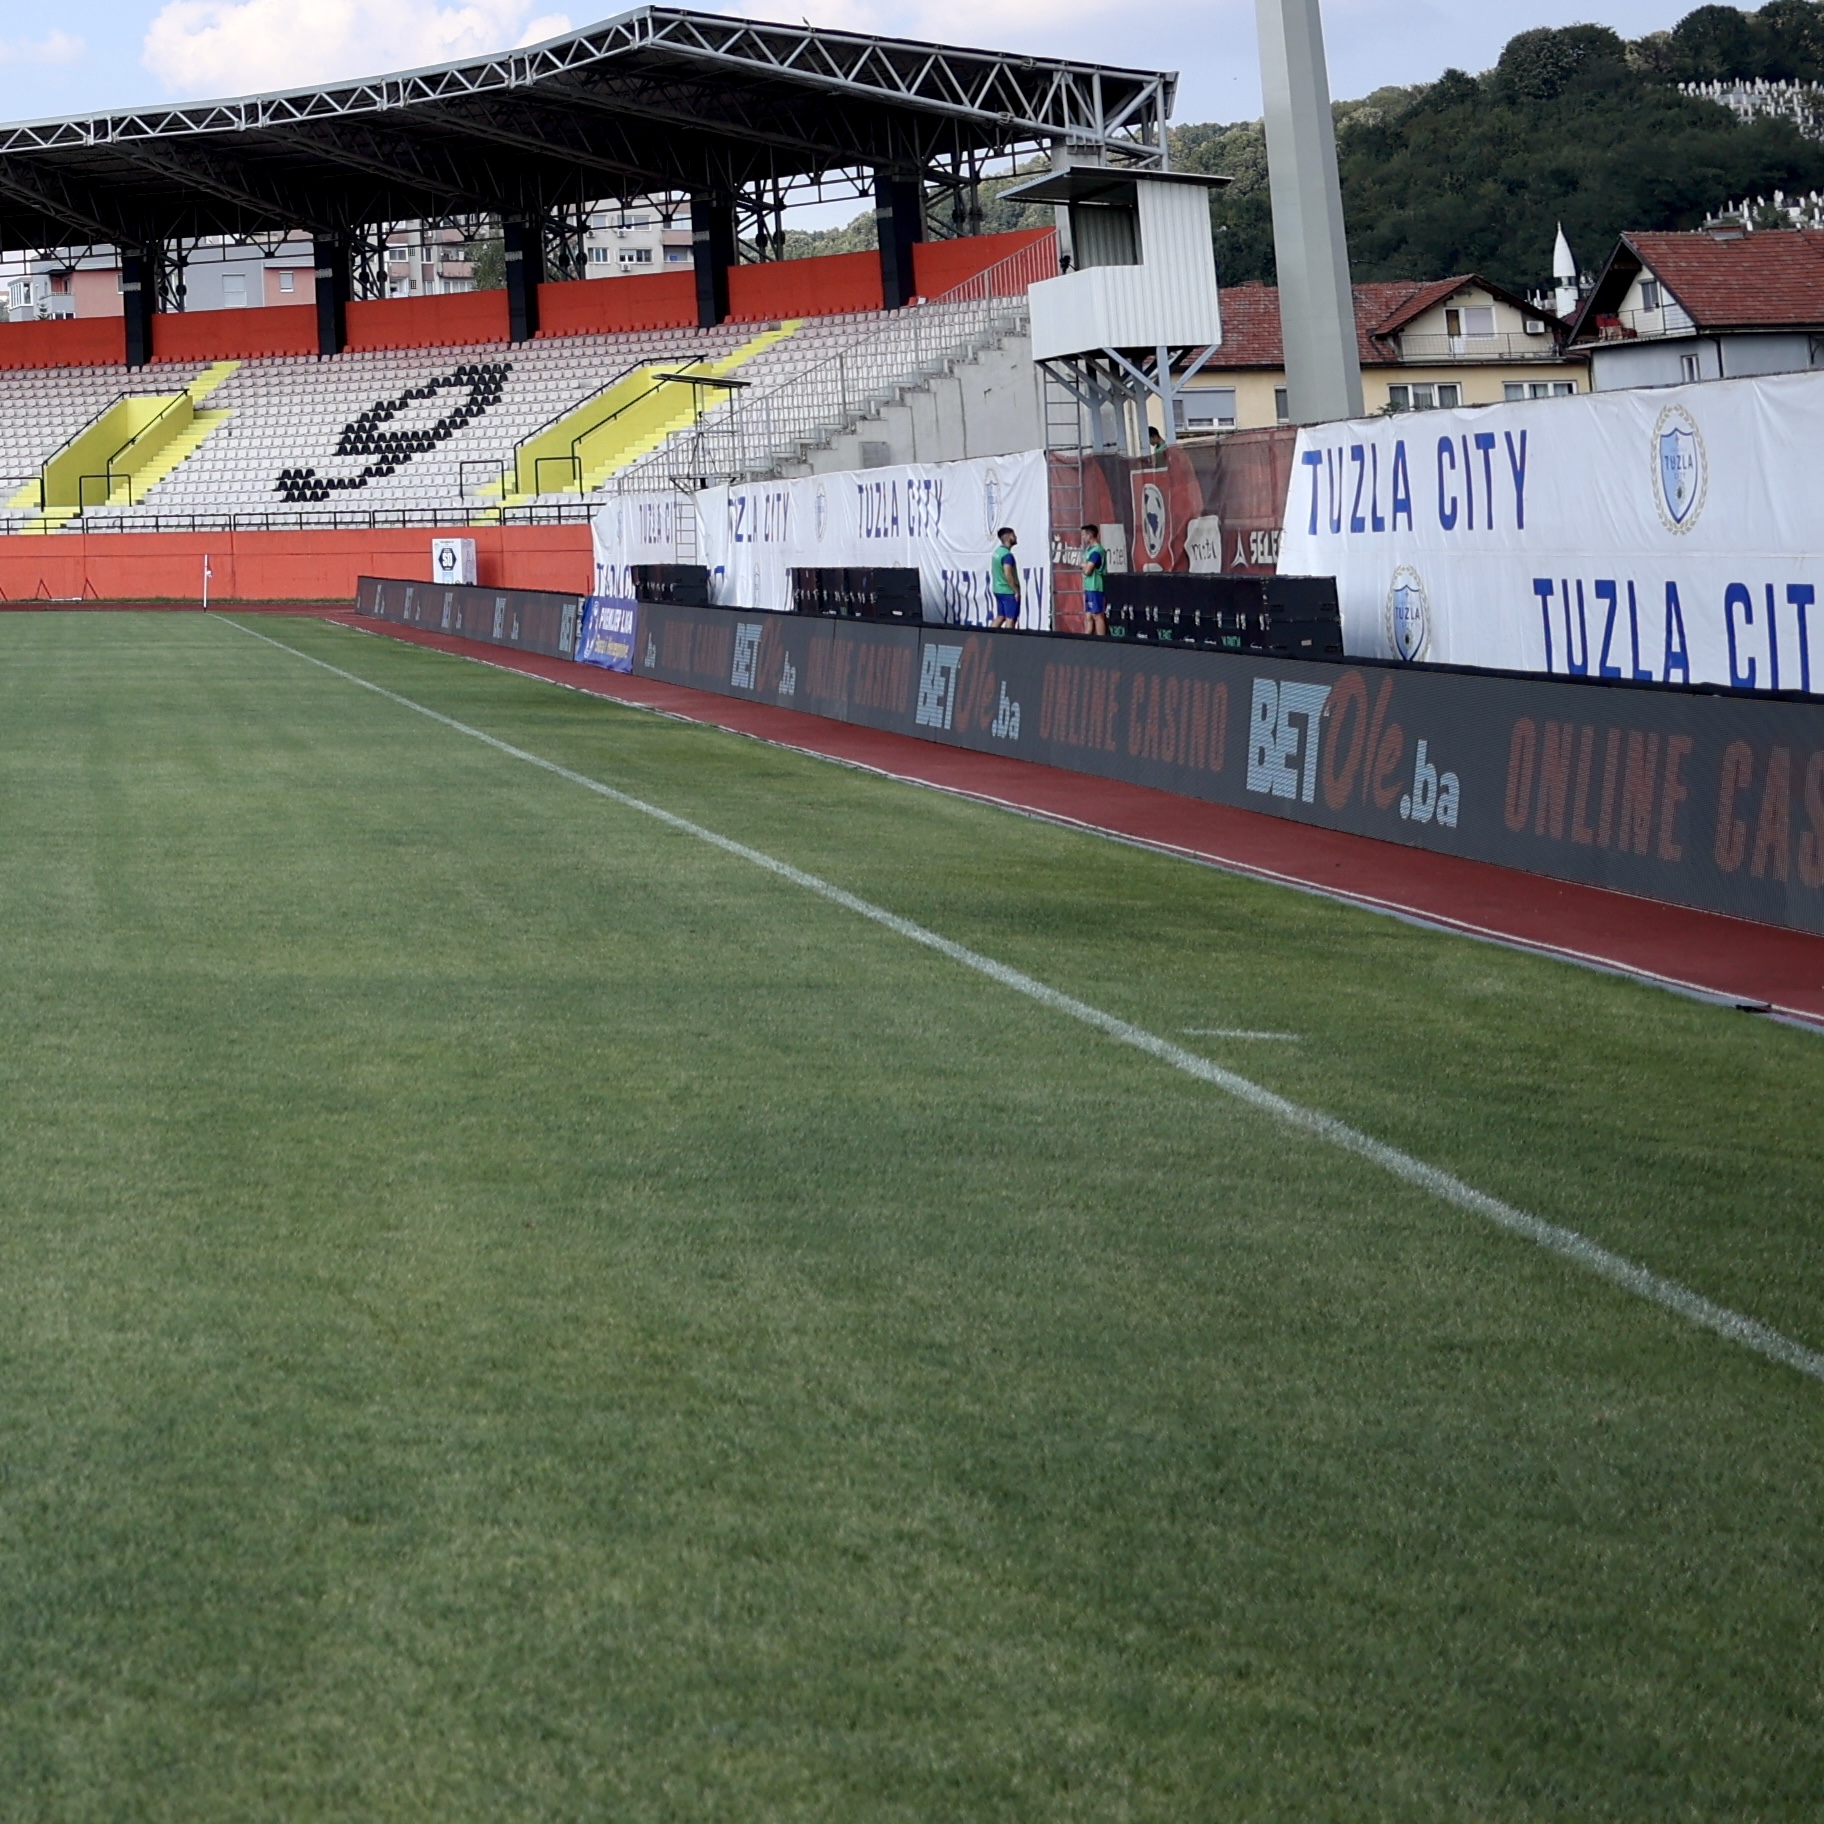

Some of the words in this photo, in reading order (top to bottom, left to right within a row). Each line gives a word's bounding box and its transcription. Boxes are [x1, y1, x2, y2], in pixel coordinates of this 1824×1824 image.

[1302, 438, 1413, 536] TUZLA
[1437, 429, 1527, 532] CITY
[1664, 454, 1694, 471] TUZLA
[764, 491, 790, 543] CITY
[857, 479, 900, 539] TUZLA
[907, 478, 943, 539] CITY
[942, 568, 995, 628] TUZLA
[1394, 606, 1421, 621] TUZLA
[1533, 578, 1691, 685] TUZLA
[1724, 582, 1815, 693] CIT
[1039, 661, 1122, 753] ONLINE
[1128, 671, 1230, 773] CASINO
[1504, 716, 1695, 864] ONLINE
